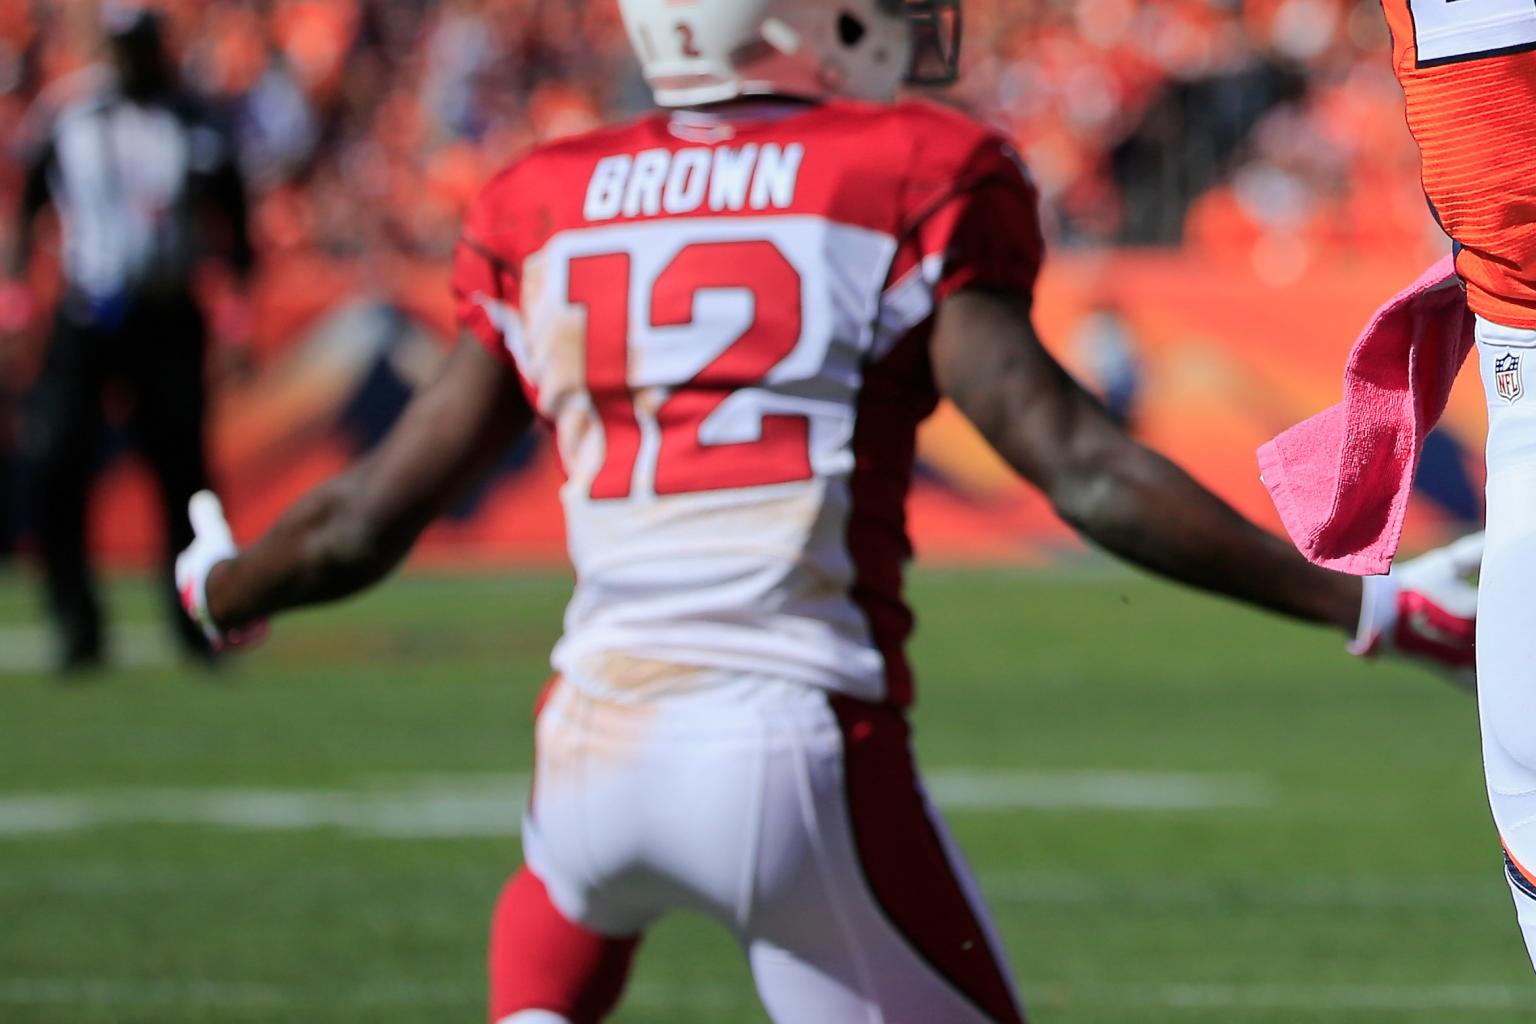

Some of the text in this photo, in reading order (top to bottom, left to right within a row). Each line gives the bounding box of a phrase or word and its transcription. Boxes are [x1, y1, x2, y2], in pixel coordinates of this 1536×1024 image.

[582, 142, 806, 222] BROWN
[567, 239, 814, 501] 12
[1497, 372, 1518, 396] NFL
